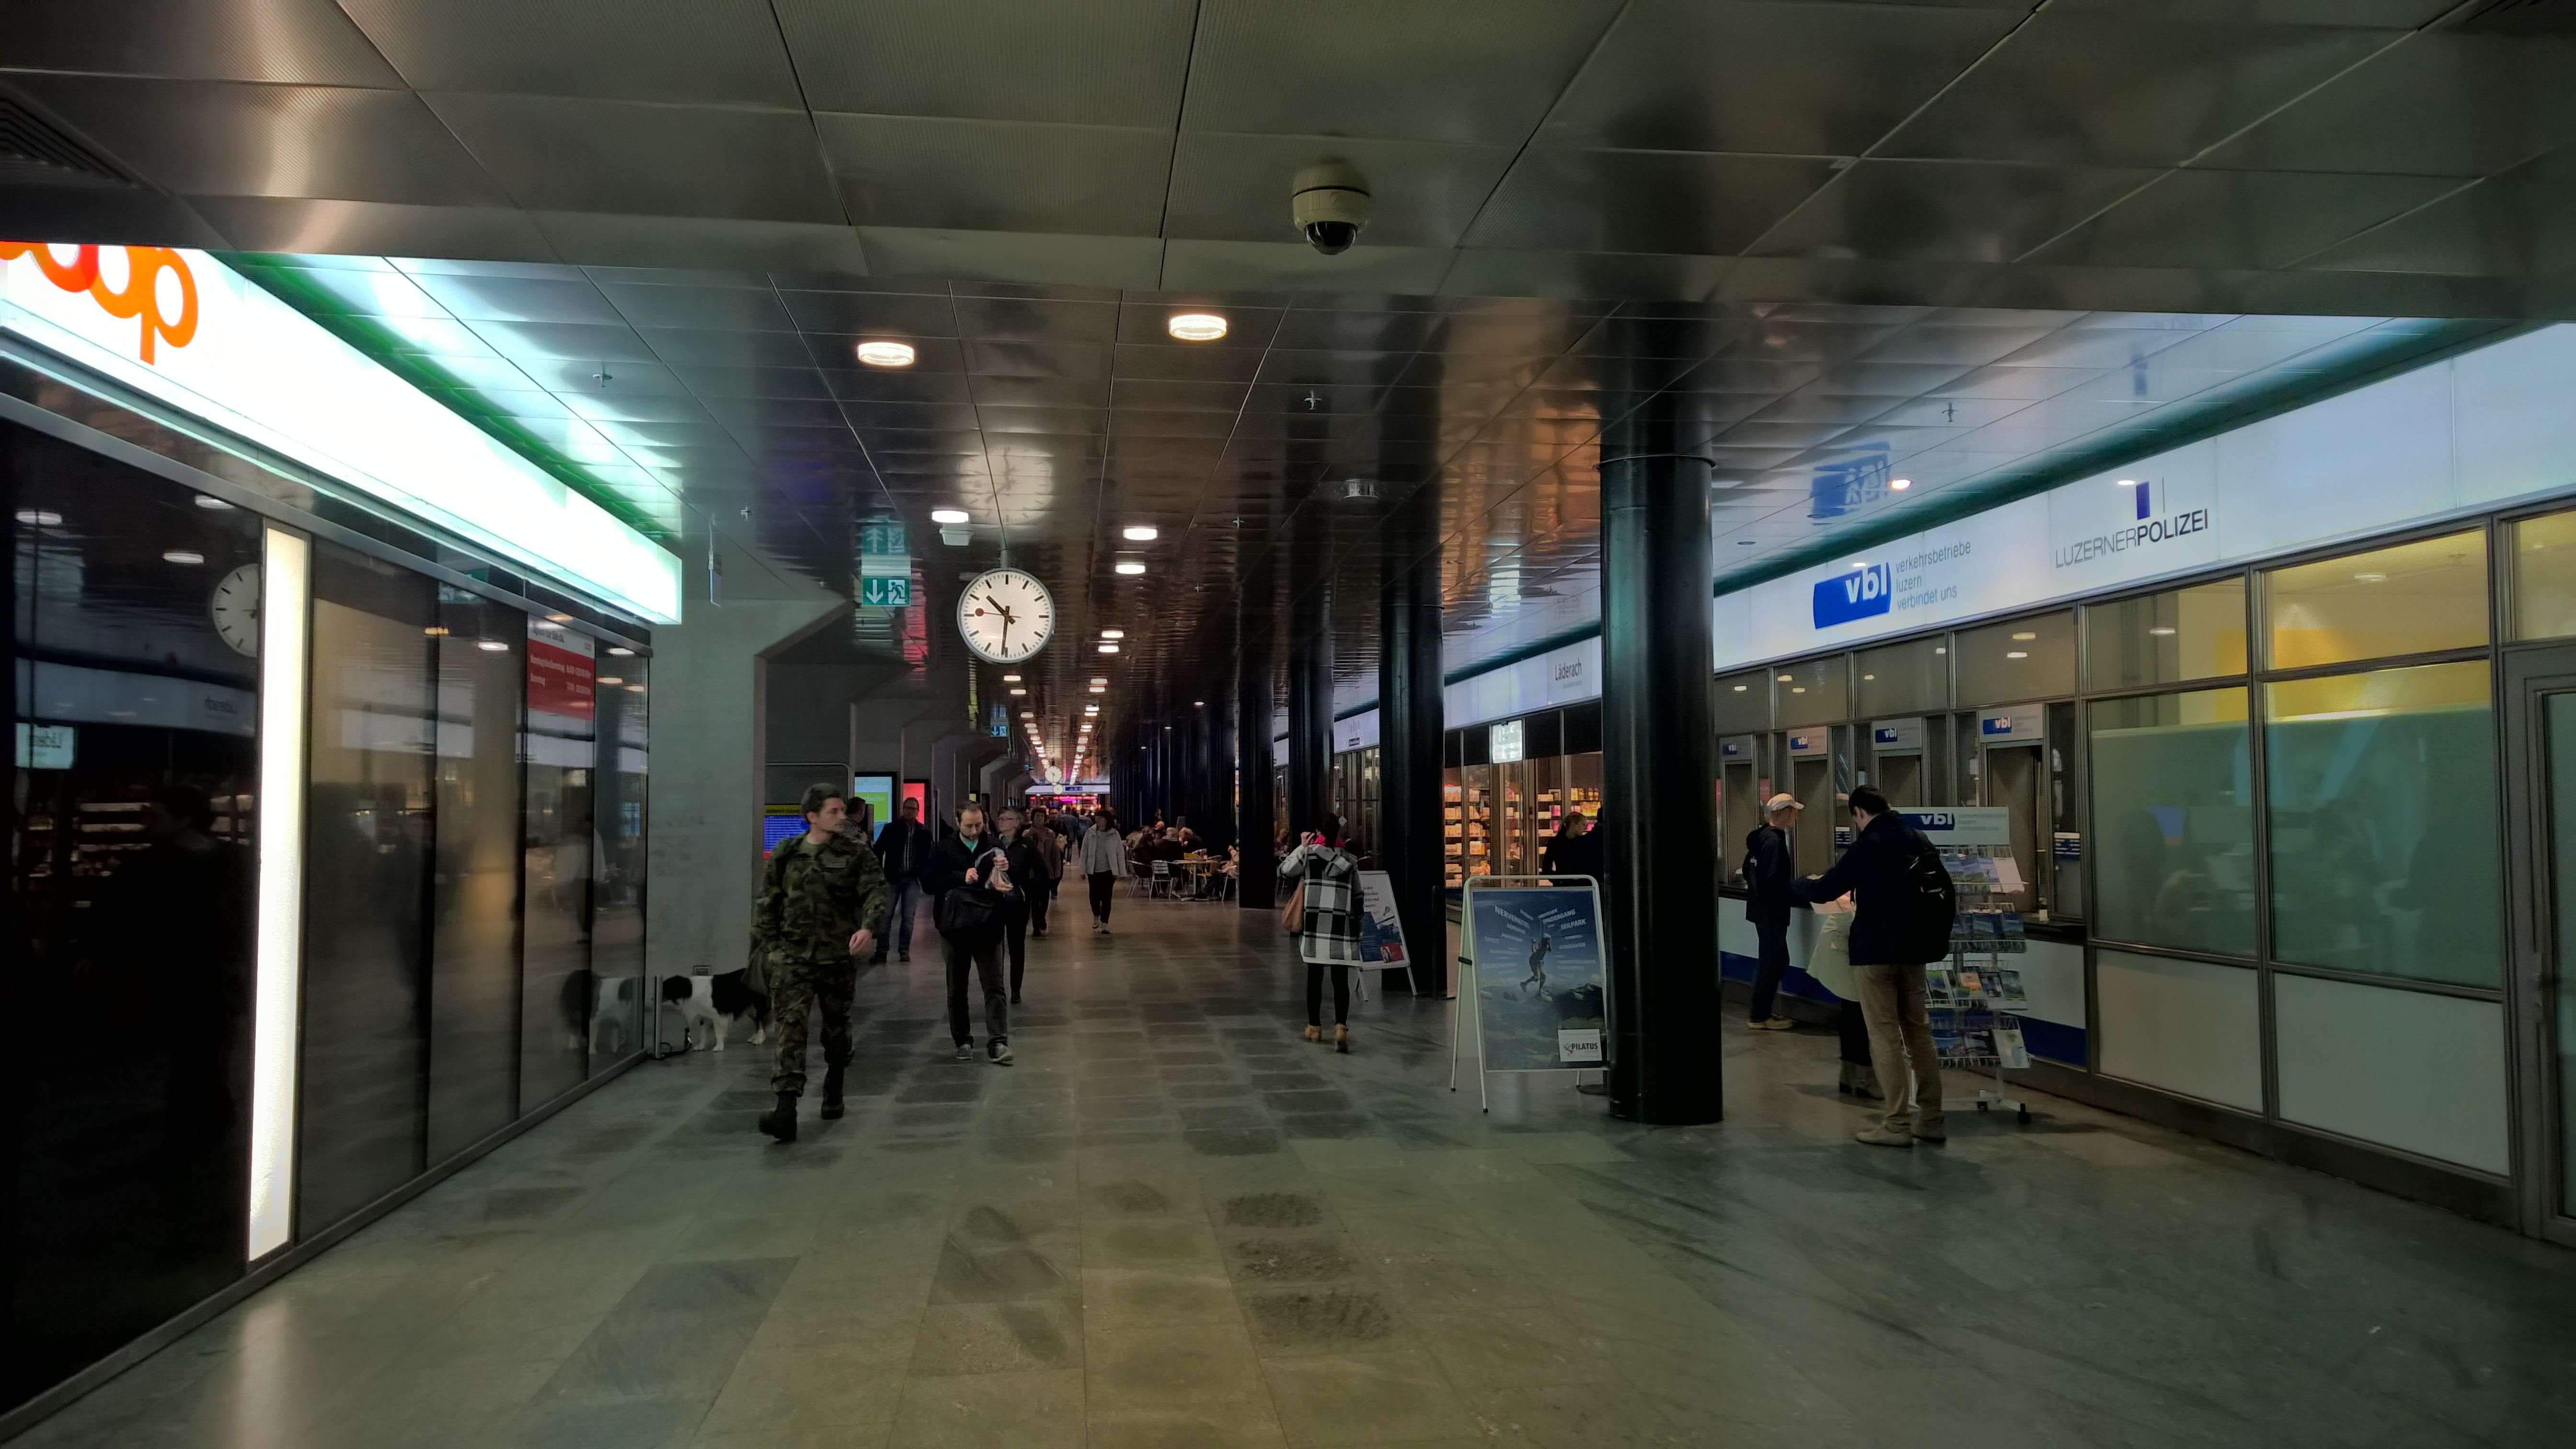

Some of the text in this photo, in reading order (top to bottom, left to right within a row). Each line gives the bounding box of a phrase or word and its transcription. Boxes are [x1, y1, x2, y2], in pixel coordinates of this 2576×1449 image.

[2055, 508, 2208, 568] LUZERNERPOLIZEI
[1895, 539, 1971, 574] verkehrsbetriebe
[1845, 562, 1887, 604] vbl
[1896, 575, 1922, 593] luzern
[1897, 585, 1958, 610] verbindet uns
[1554, 657, 1582, 681] Läderach
[1995, 716, 2011, 728] vbl
[1884, 727, 1897, 739] vbl
[1728, 742, 1736, 752] vbl
[1797, 736, 1808, 746] vbl
[1920, 813, 1953, 825] vbl
[1560, 919, 1587, 930] SEILPARK
